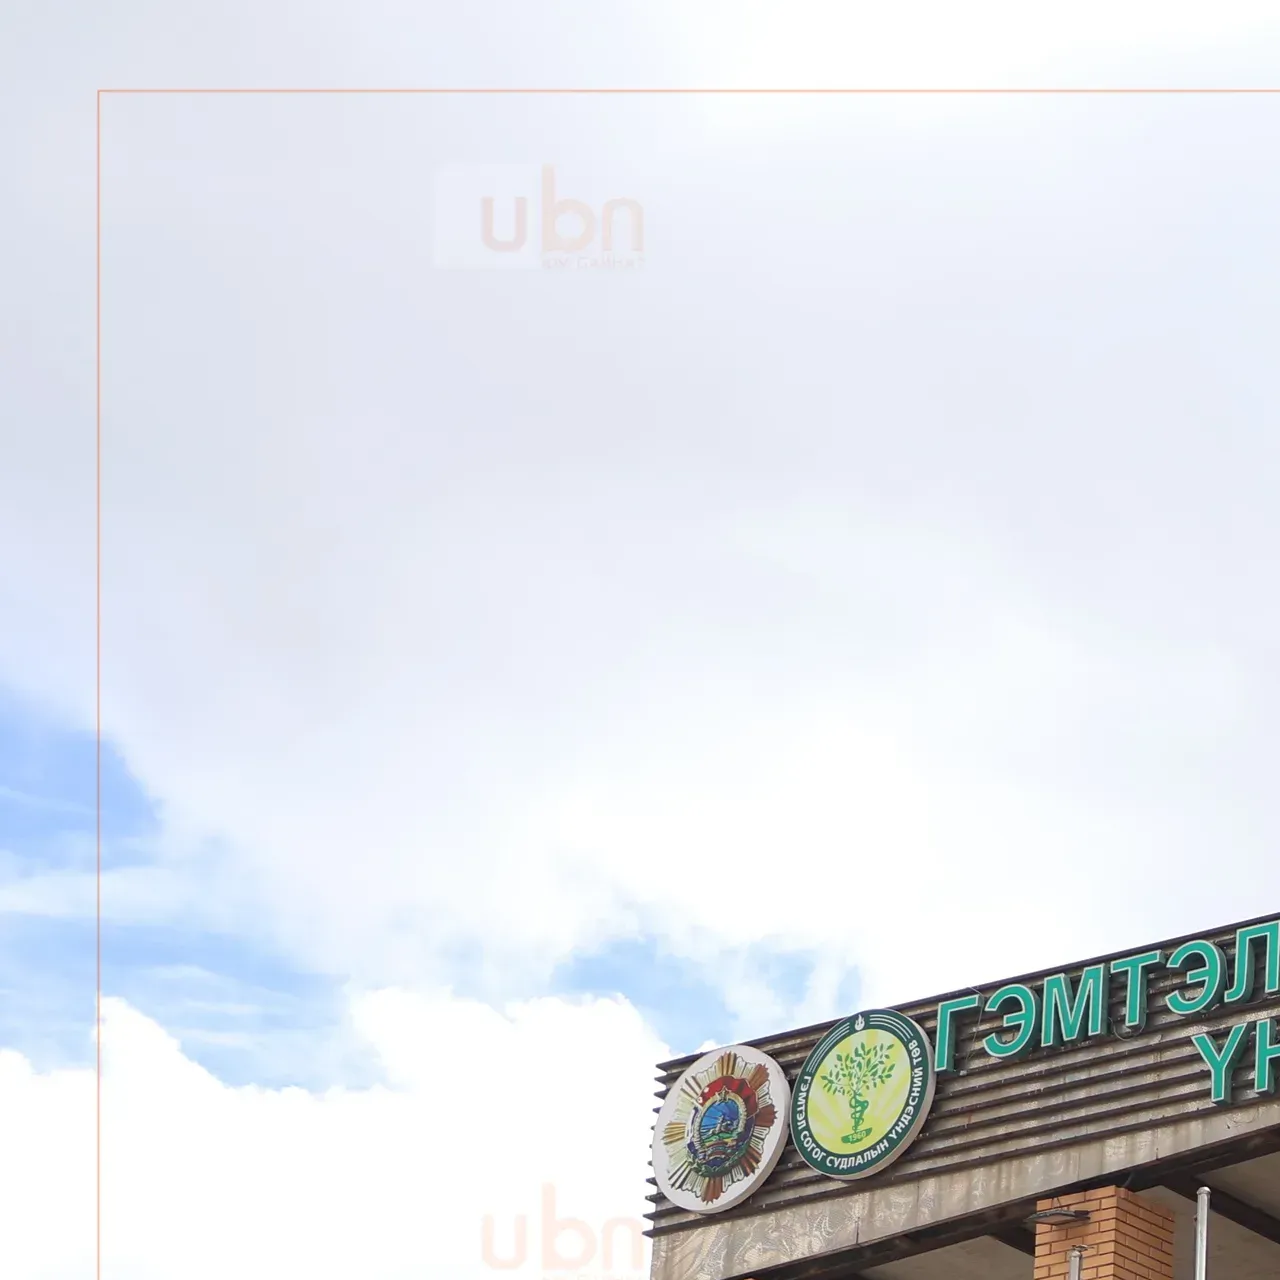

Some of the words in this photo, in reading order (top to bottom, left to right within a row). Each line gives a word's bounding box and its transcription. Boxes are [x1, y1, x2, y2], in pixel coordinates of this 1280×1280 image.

[908, 1039, 923, 1065] ТӨВ
[795, 1075, 812, 1129] ГЭМТЭЛ
[888, 1066, 924, 1140] ҮНДЭСНИЙ
[800, 1131, 827, 1162] СОГОГ
[826, 1140, 889, 1170] СУДЛАЛЫН
